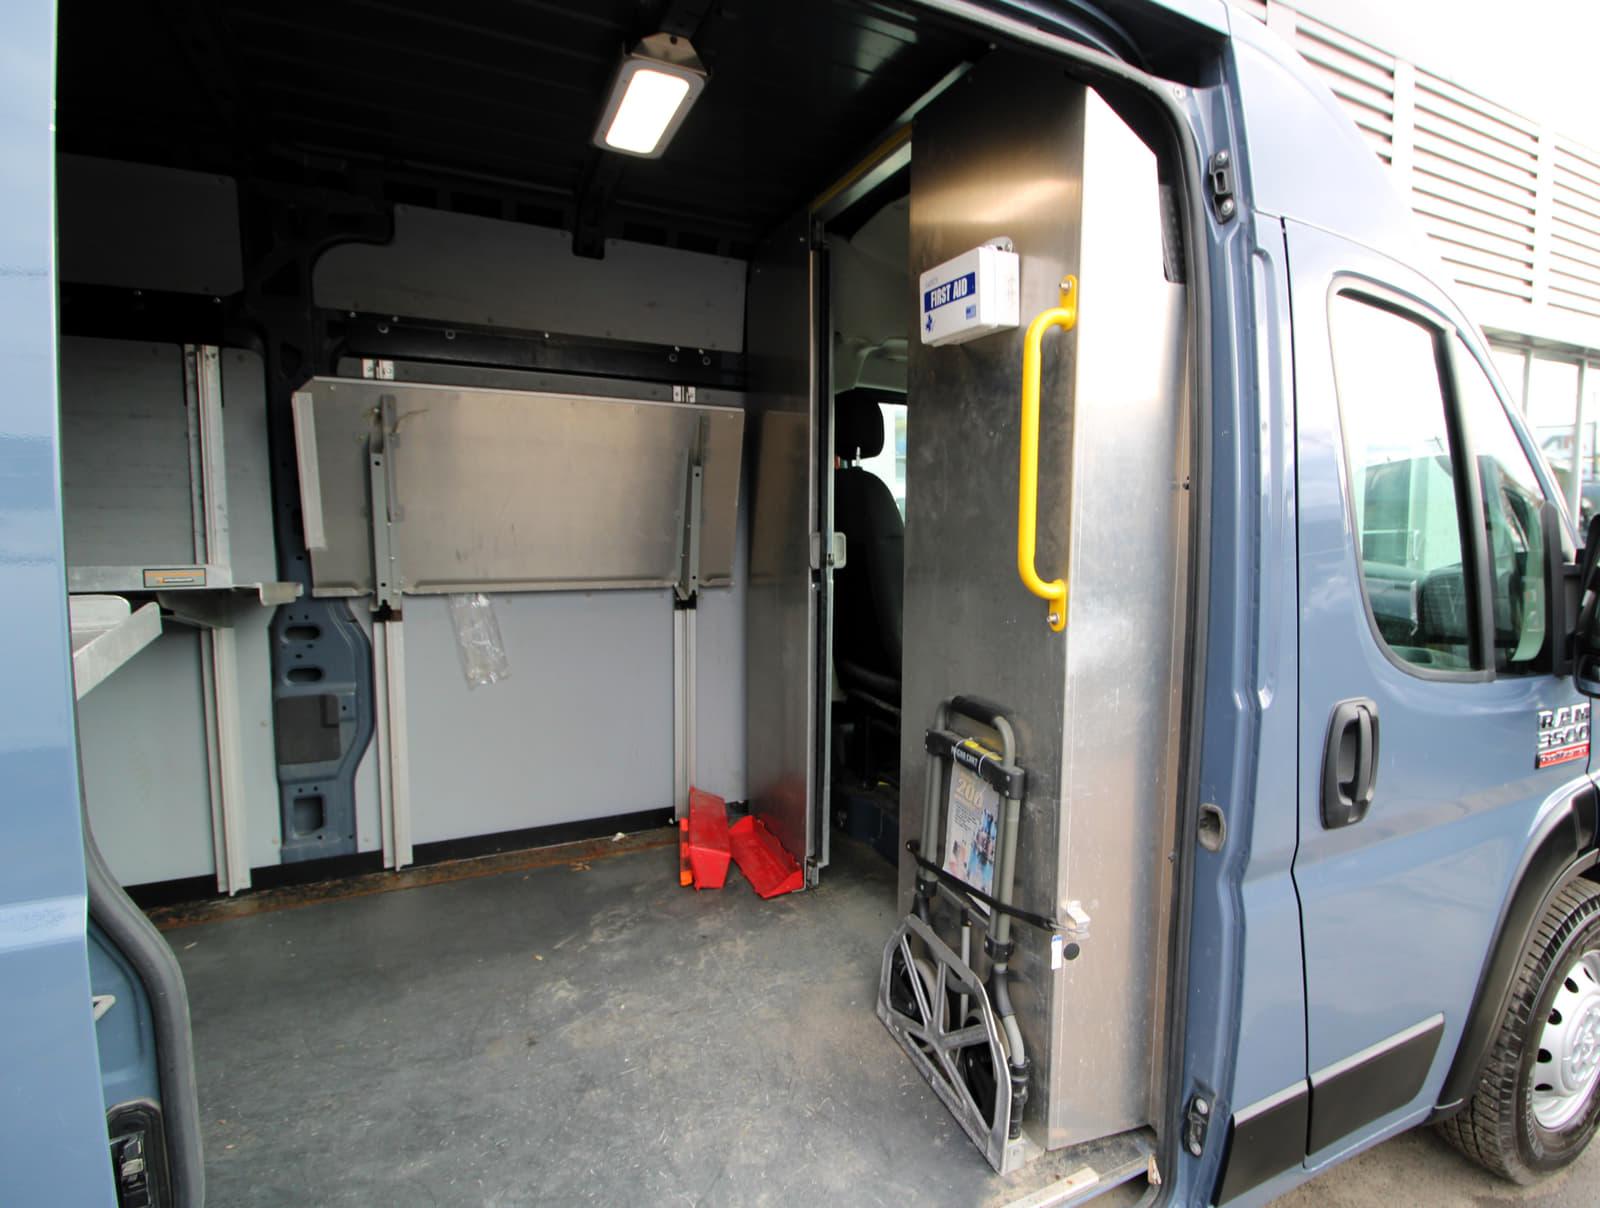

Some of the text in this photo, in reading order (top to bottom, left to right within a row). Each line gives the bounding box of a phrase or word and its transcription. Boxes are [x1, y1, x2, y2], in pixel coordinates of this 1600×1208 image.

[930, 284, 951, 309] FIRST
[953, 277, 968, 300] AID
[1538, 703, 1590, 729] RAM
